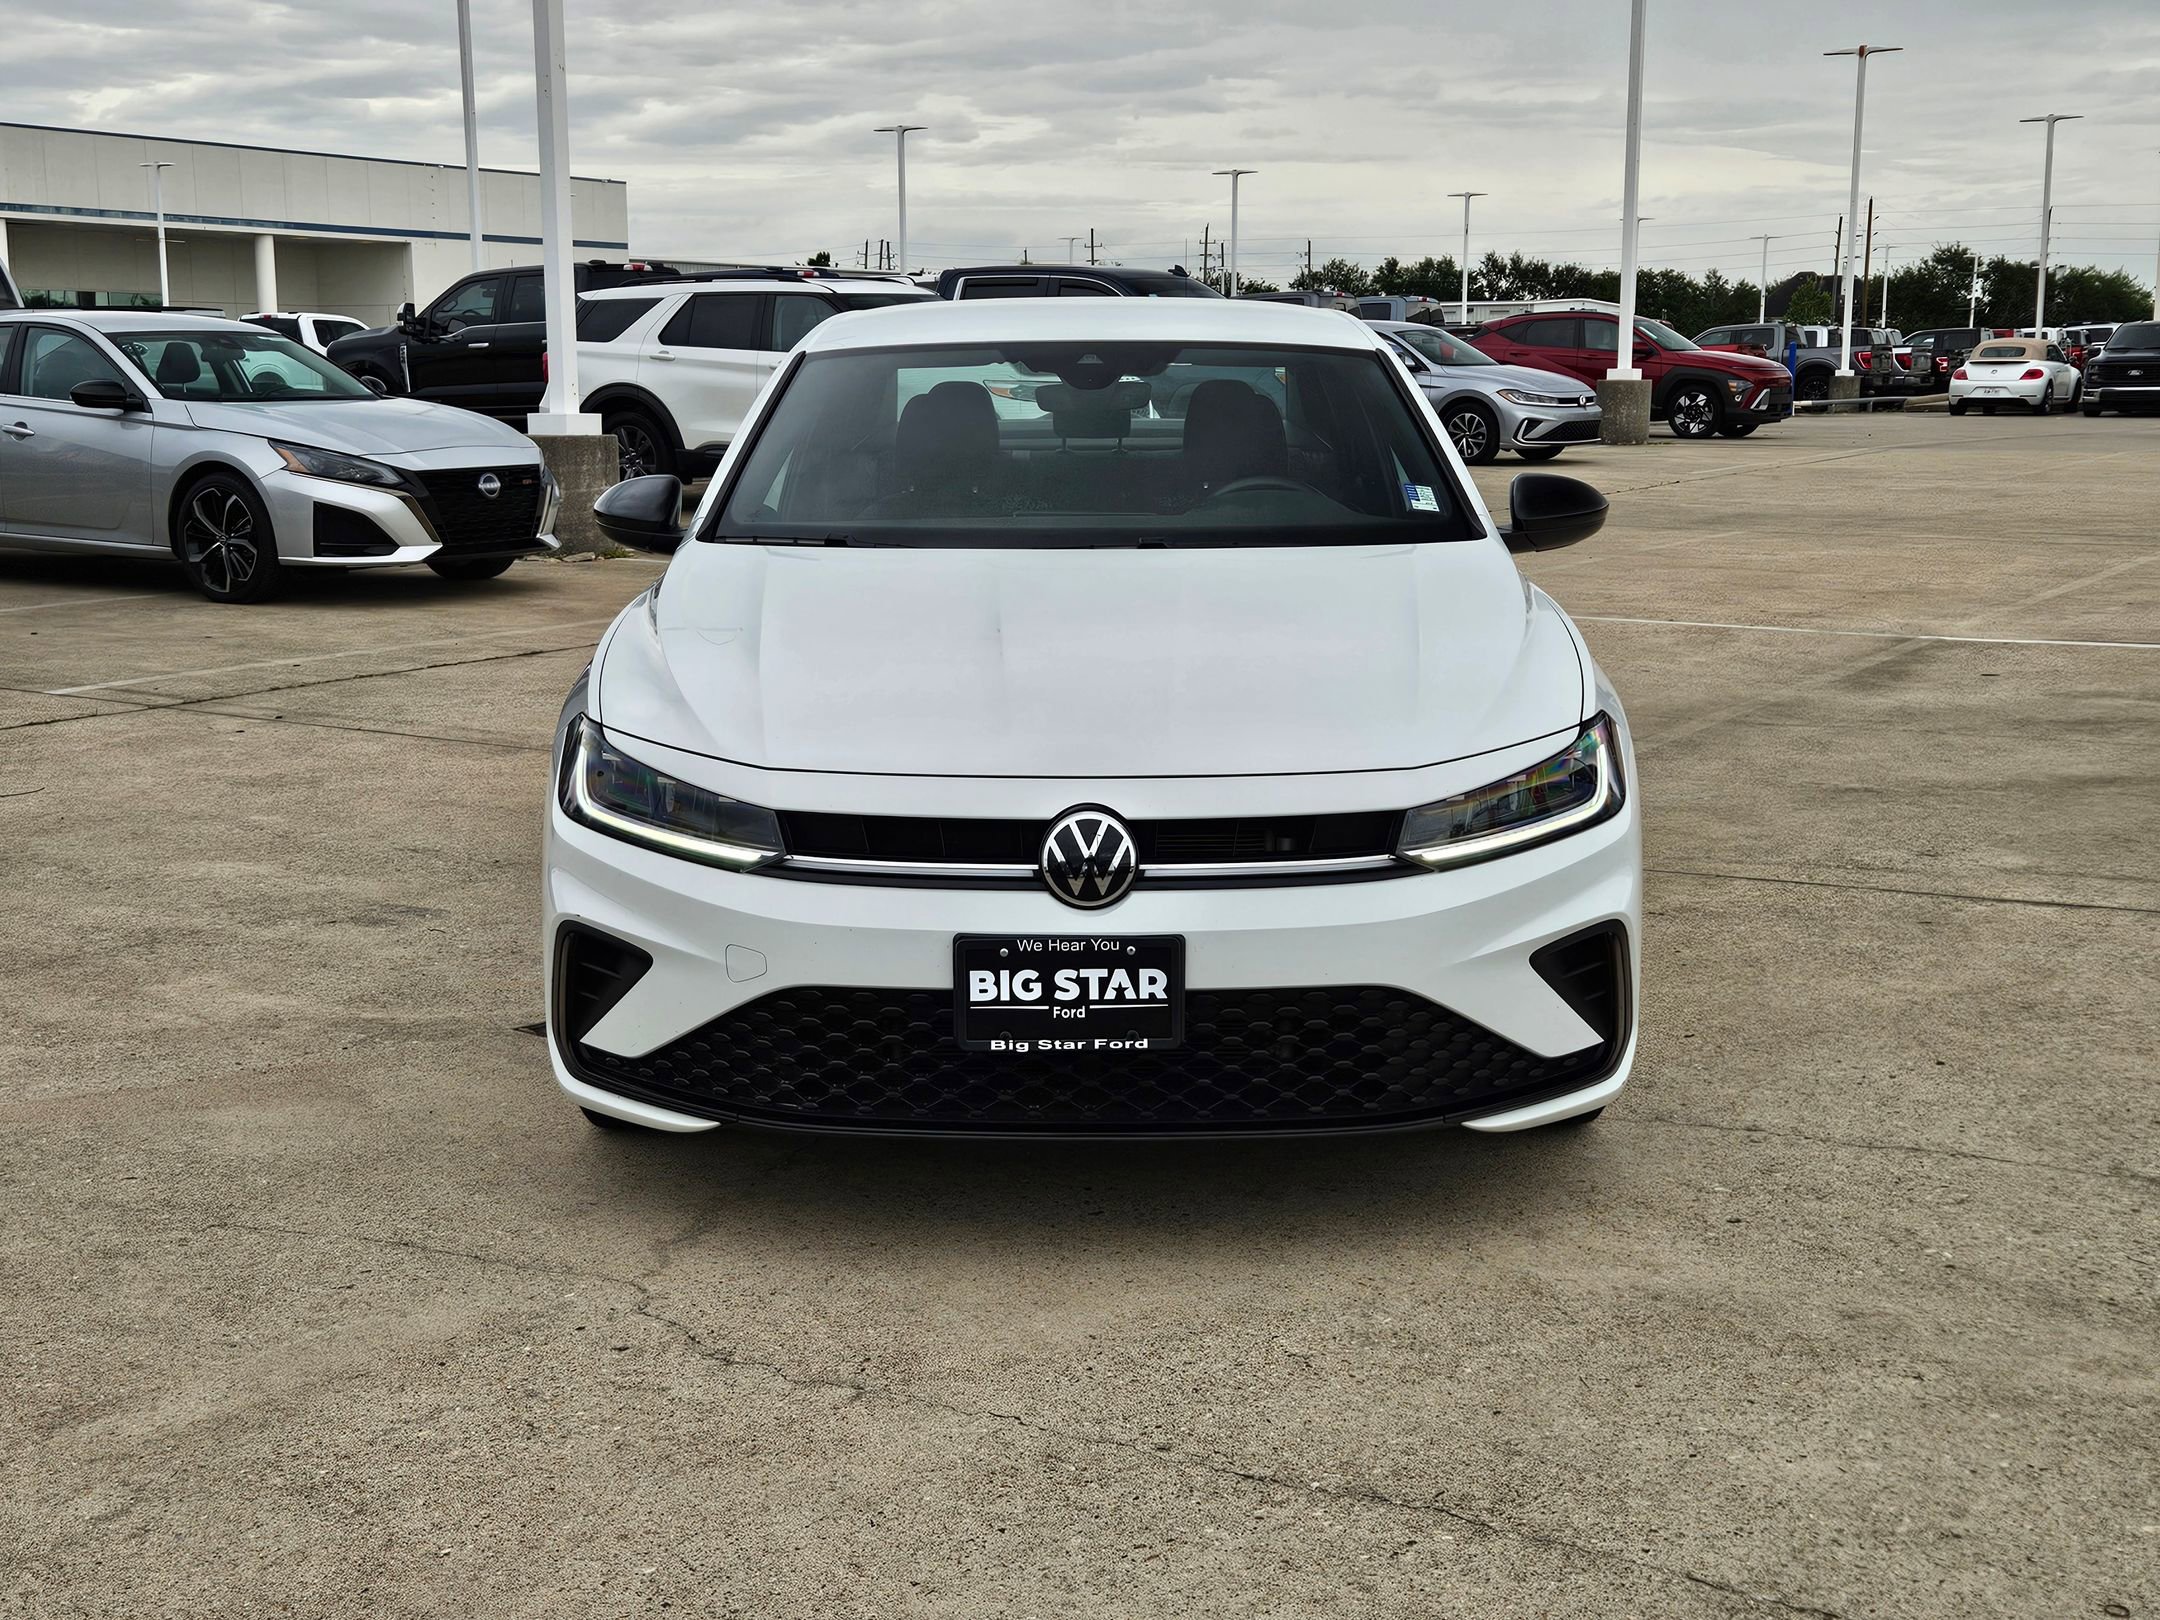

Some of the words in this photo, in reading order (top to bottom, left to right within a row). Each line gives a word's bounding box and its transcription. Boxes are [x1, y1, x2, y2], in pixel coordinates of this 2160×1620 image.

[1016, 939, 1043, 952] We
[1048, 938, 1087, 952] Hear
[1090, 938, 1120, 951] You
[969, 969, 1043, 1002] BIG
[1053, 968, 1168, 1001] STAR
[1053, 1005, 1086, 1019] Ford
[990, 1039, 1029, 1053] Big
[1037, 1039, 1087, 1050] Star
[1094, 1038, 1149, 1050] Ford
